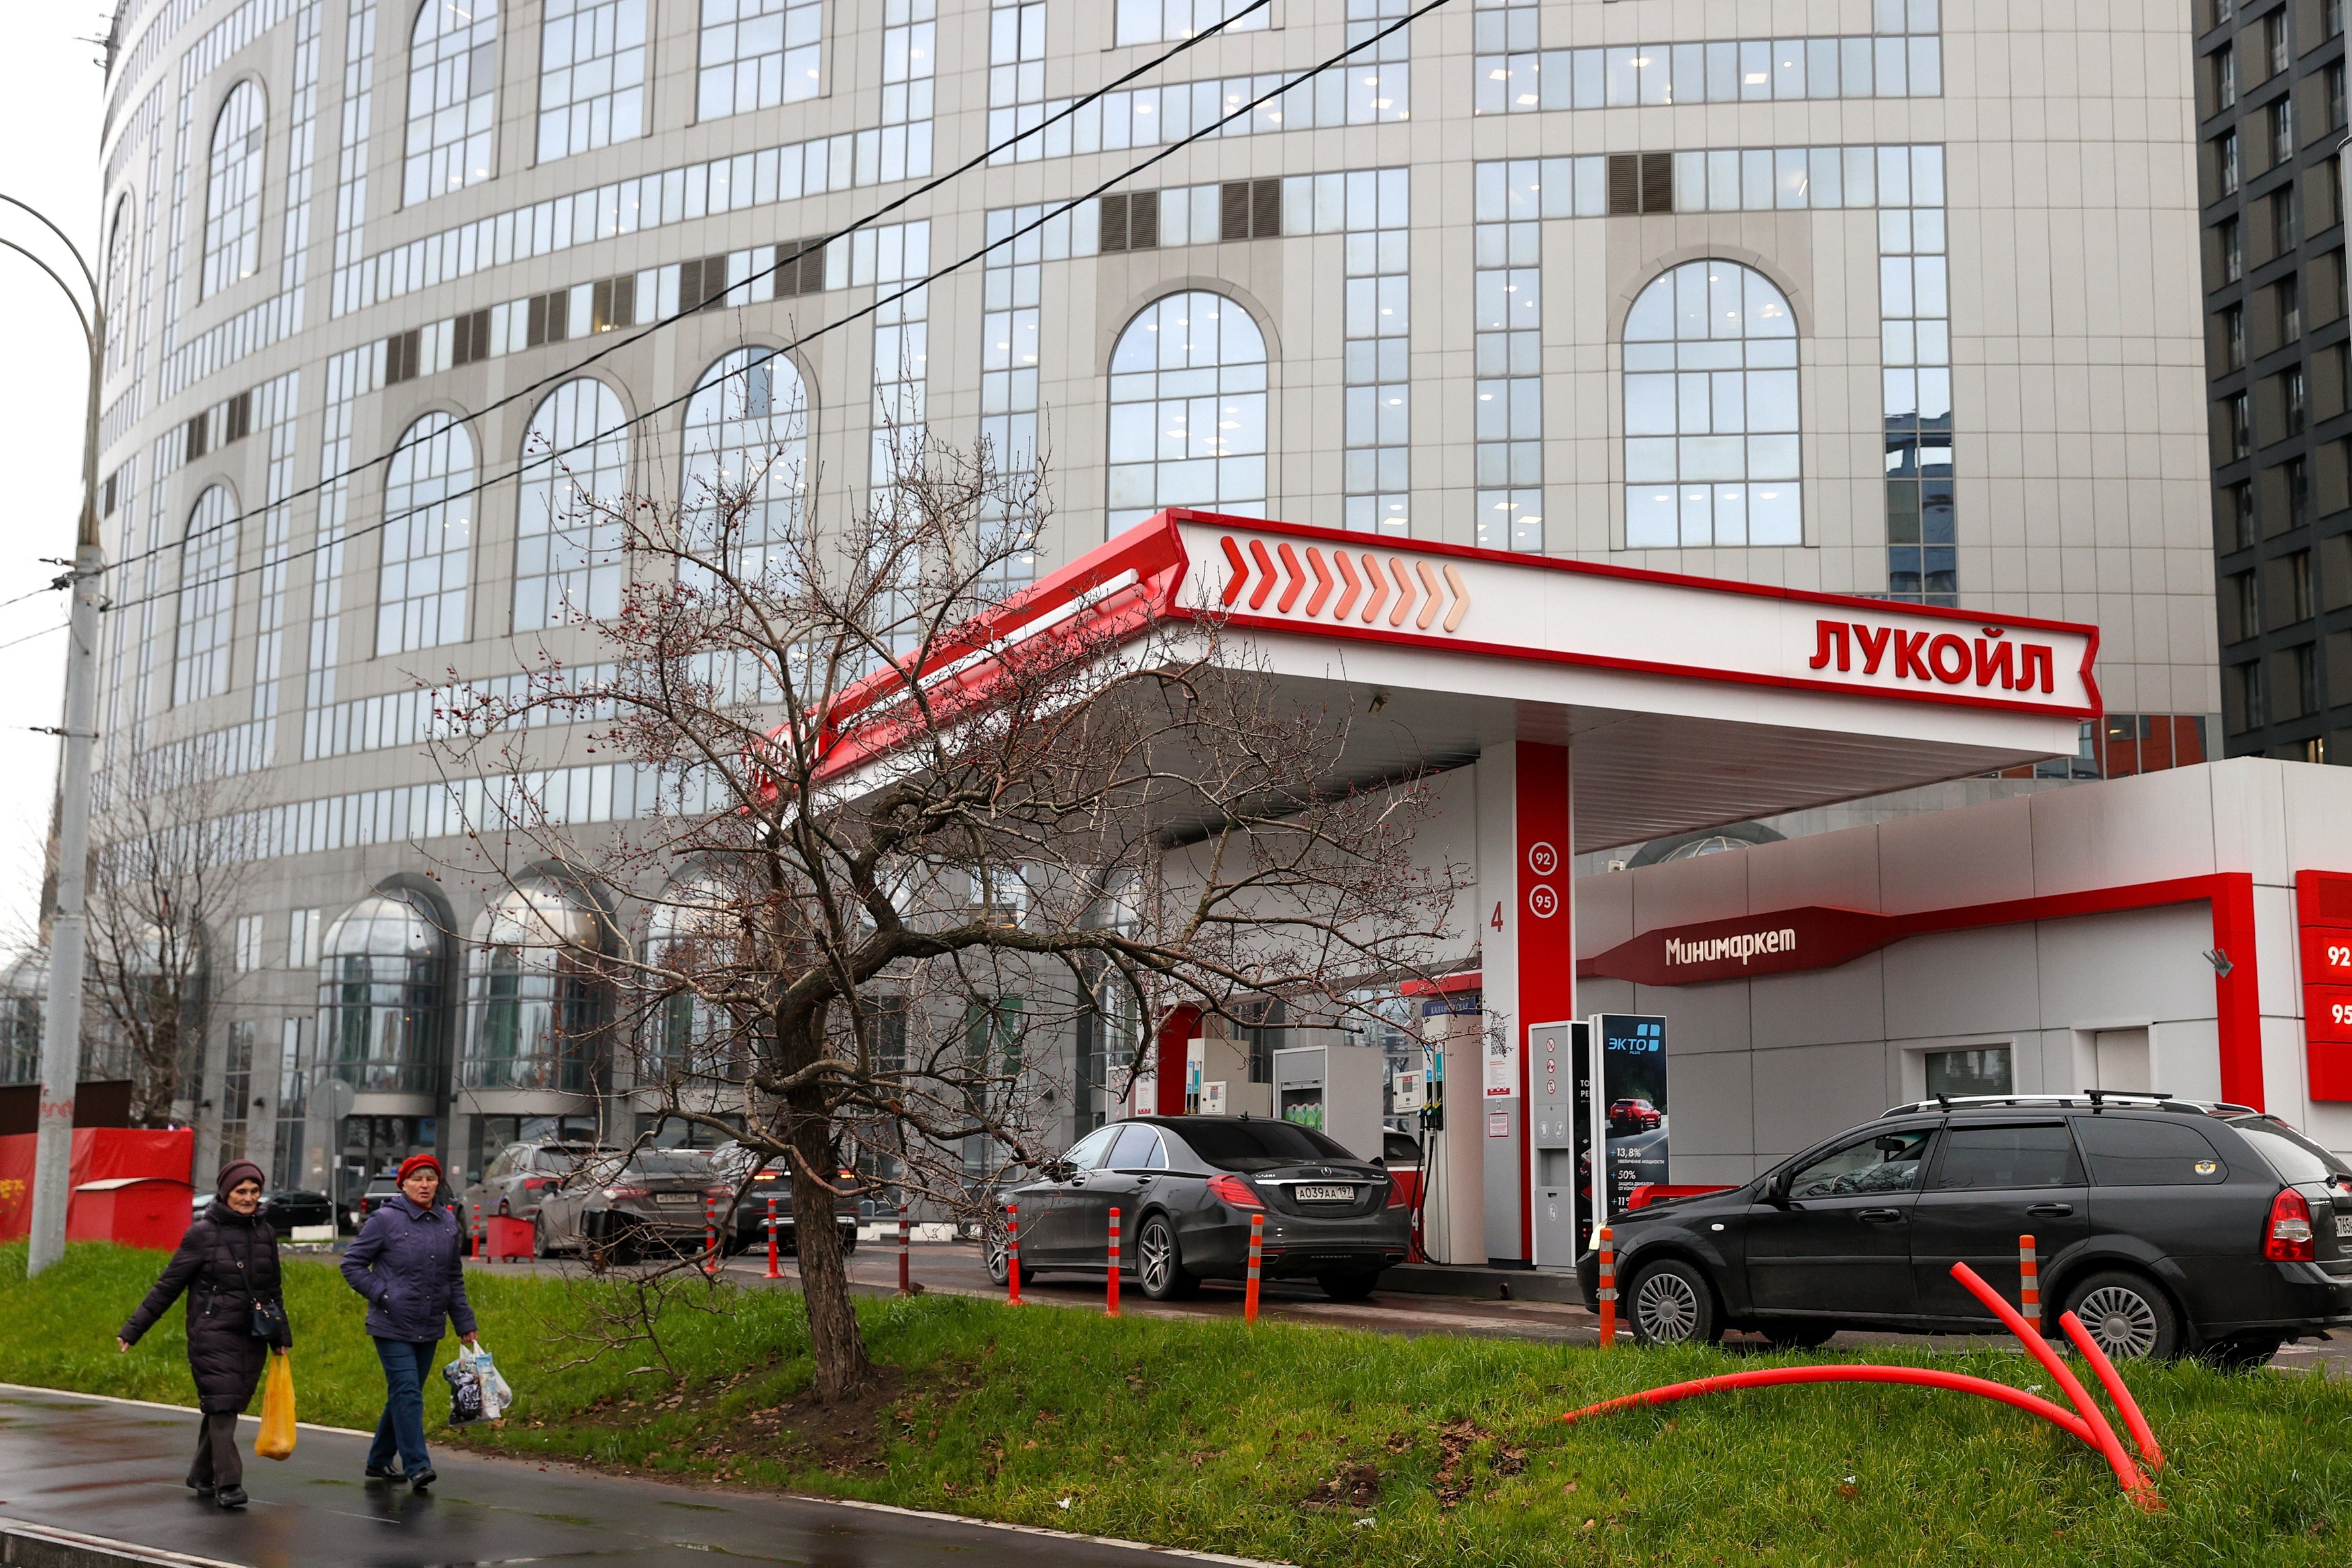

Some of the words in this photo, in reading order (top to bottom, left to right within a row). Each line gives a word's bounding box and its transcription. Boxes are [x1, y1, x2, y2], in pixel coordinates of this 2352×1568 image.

[1809, 620, 2054, 693] ЛУКОЙЛ
[1536, 852, 1551, 865] 92
[1536, 895, 1551, 909] 95
[1491, 901, 1503, 932] 4
[1665, 928, 1796, 966] Минимаркет
[2327, 946, 2351, 966] 92
[2331, 1004, 2352, 1025] 95
[1608, 1038, 1647, 1051] ЭКТО
[1300, 1187, 1336, 1198] А039АА
[1337, 1186, 1351, 1195] 197
[1412, 1207, 1418, 1231] 4
